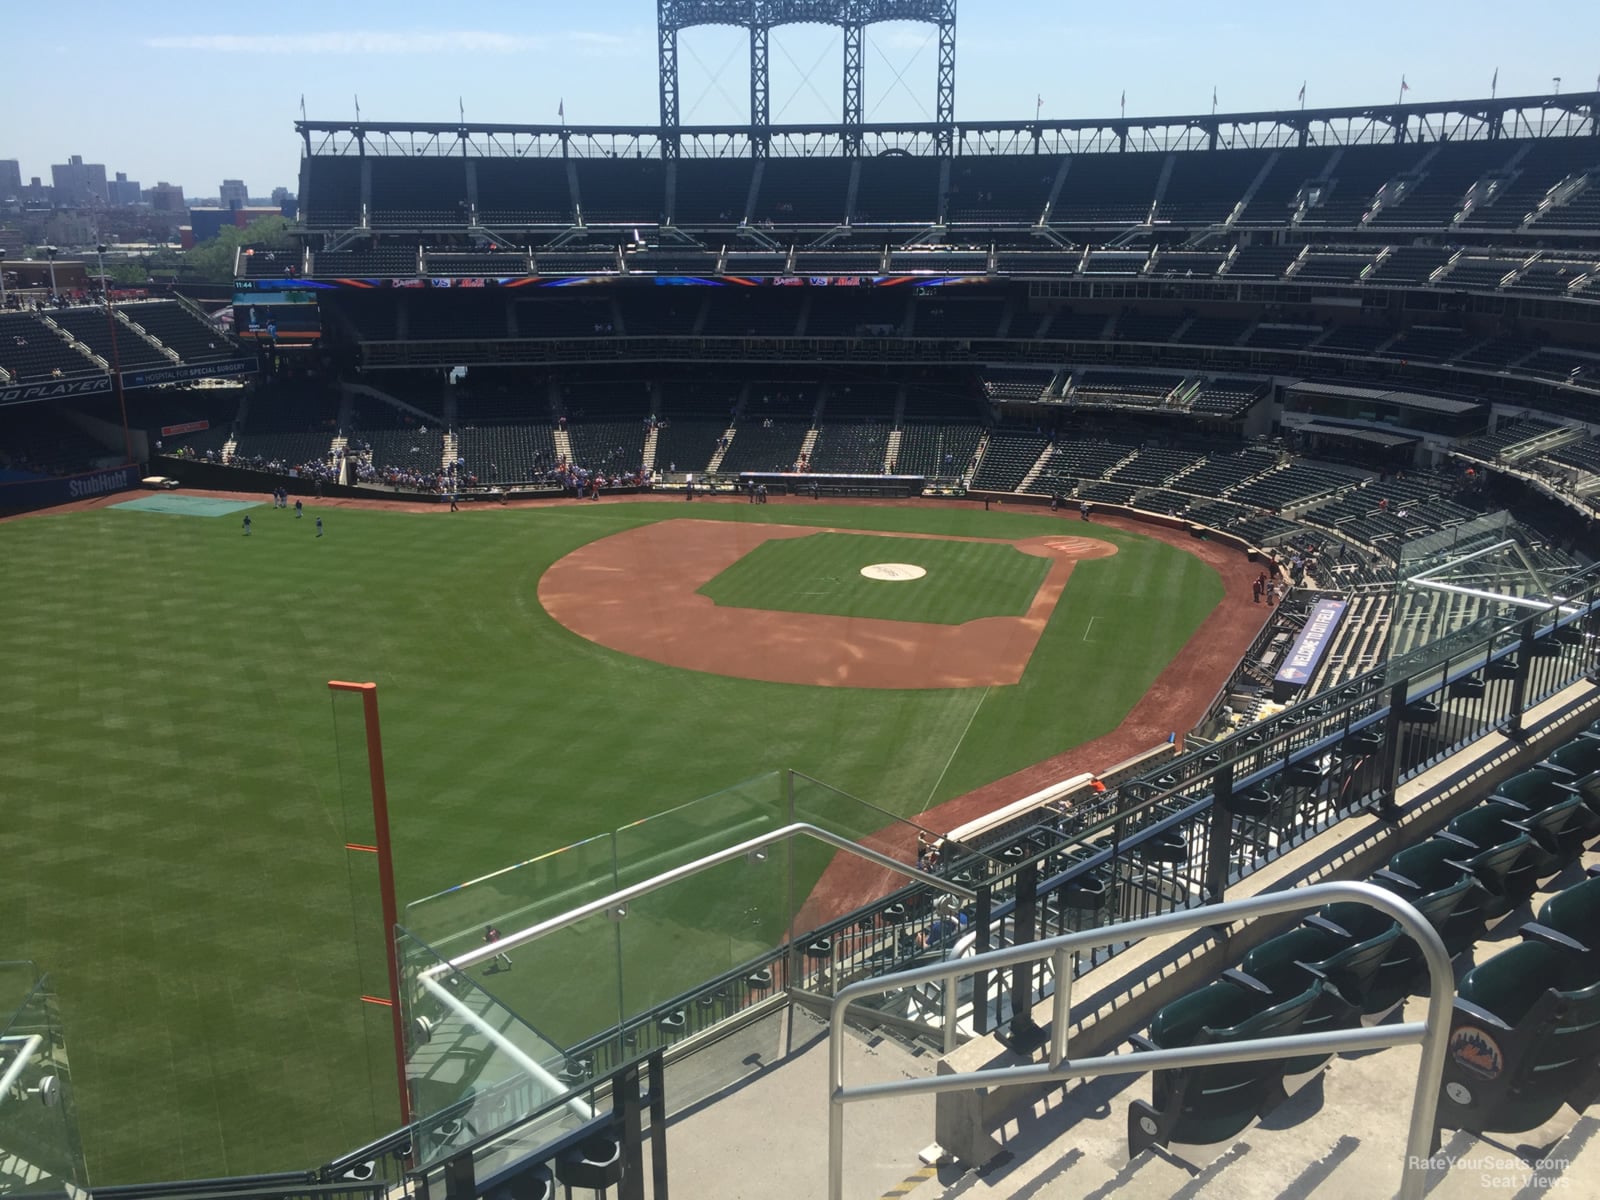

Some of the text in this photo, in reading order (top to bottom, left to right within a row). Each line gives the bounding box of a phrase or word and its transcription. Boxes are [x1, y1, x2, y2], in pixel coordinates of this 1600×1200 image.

[433, 279, 450, 287] VS
[810, 277, 827, 285] VS
[145, 371, 176, 382] HOSPITAL
[189, 366, 216, 376] SPECIAL
[217, 363, 246, 373] SURGERY
[24, 379, 109, 398] PLAYER
[69, 470, 128, 497] StubHub!
[1290, 640, 1319, 666] WELCOME
[1306, 631, 1323, 640] TO
[1315, 609, 1335, 622] FIELD
